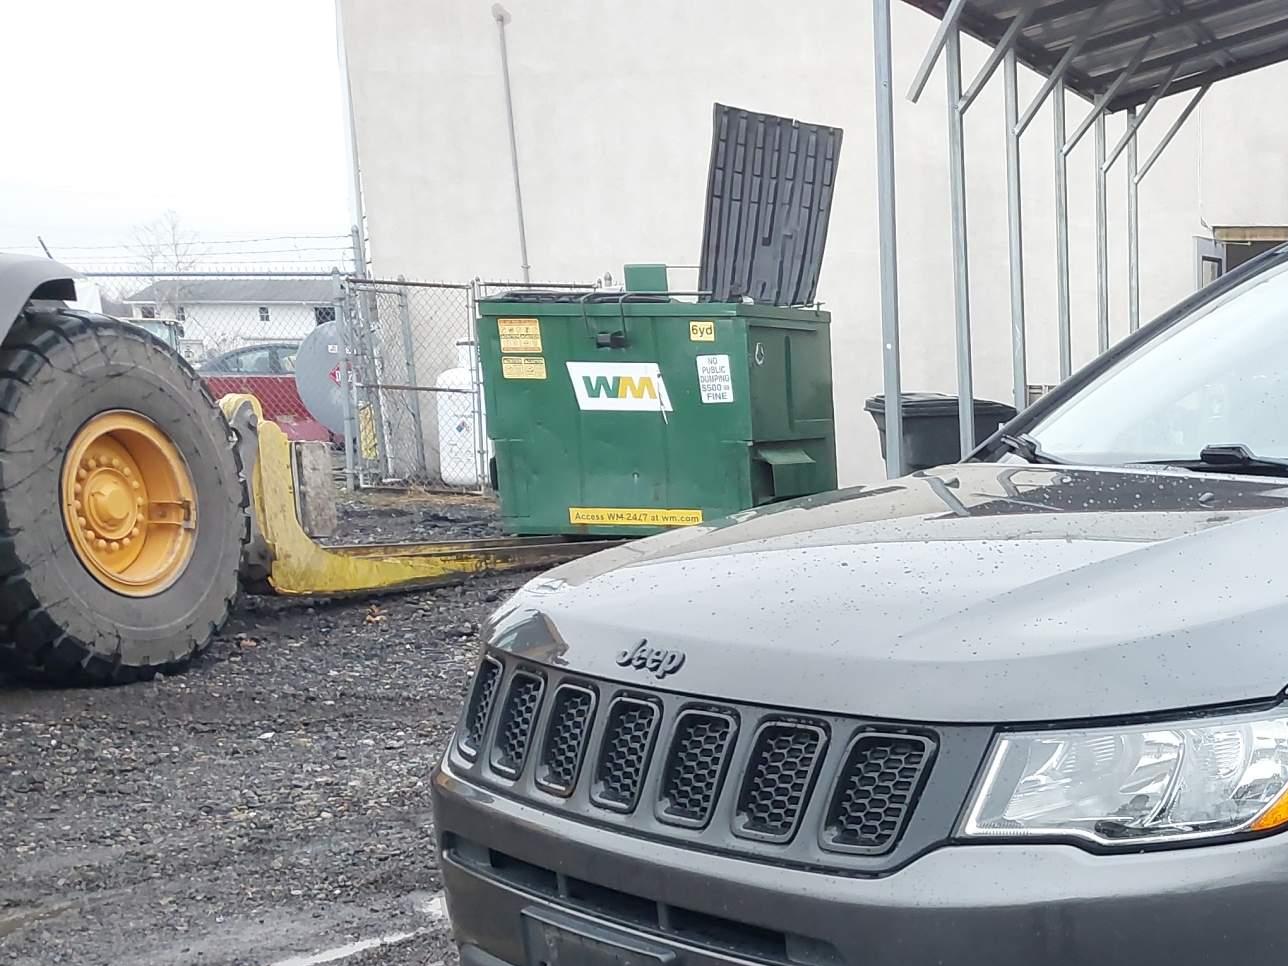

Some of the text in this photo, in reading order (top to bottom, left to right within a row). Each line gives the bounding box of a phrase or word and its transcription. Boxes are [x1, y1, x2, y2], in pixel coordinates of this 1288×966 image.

[691, 325, 713, 338] 6yd
[707, 357, 718, 365] NO
[701, 365, 726, 374] PUBLIC
[700, 374, 730, 383] DUMPING
[582, 375, 658, 399] WM
[706, 392, 729, 401] FINE
[575, 511, 605, 521] Access
[650, 513, 659, 521] at
[661, 514, 699, 523] wm.com
[616, 638, 685, 679] Jeep
